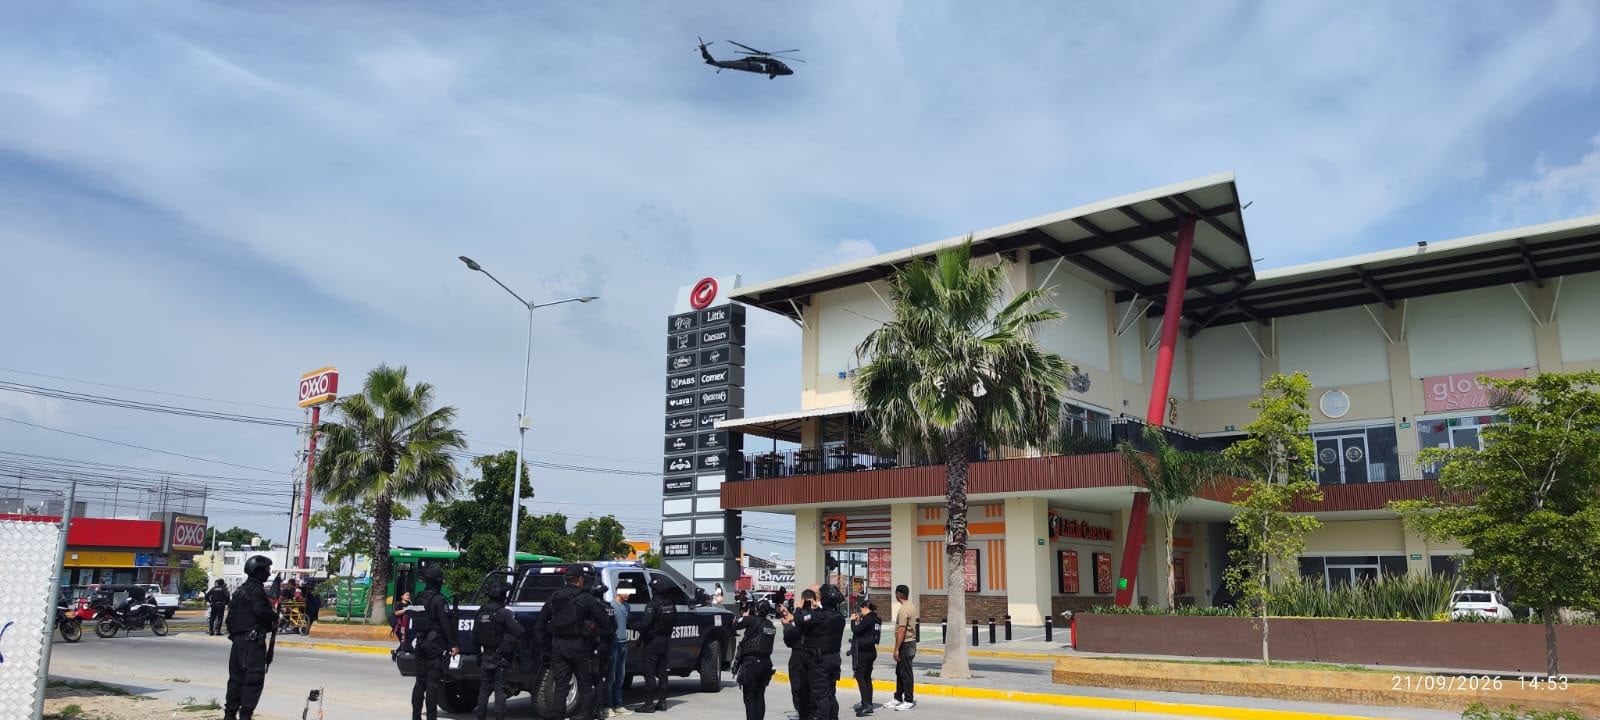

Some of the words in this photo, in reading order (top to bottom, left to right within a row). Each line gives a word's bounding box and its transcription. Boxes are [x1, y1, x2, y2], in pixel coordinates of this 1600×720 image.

[707, 309, 725, 321] Little
[703, 331, 727, 342] Caesars
[701, 370, 727, 383] Comex
[300, 373, 329, 400] OXXO
[176, 524, 205, 545] OXXO
[458, 619, 475, 631] EST
[671, 625, 700, 639] ESTATAL
